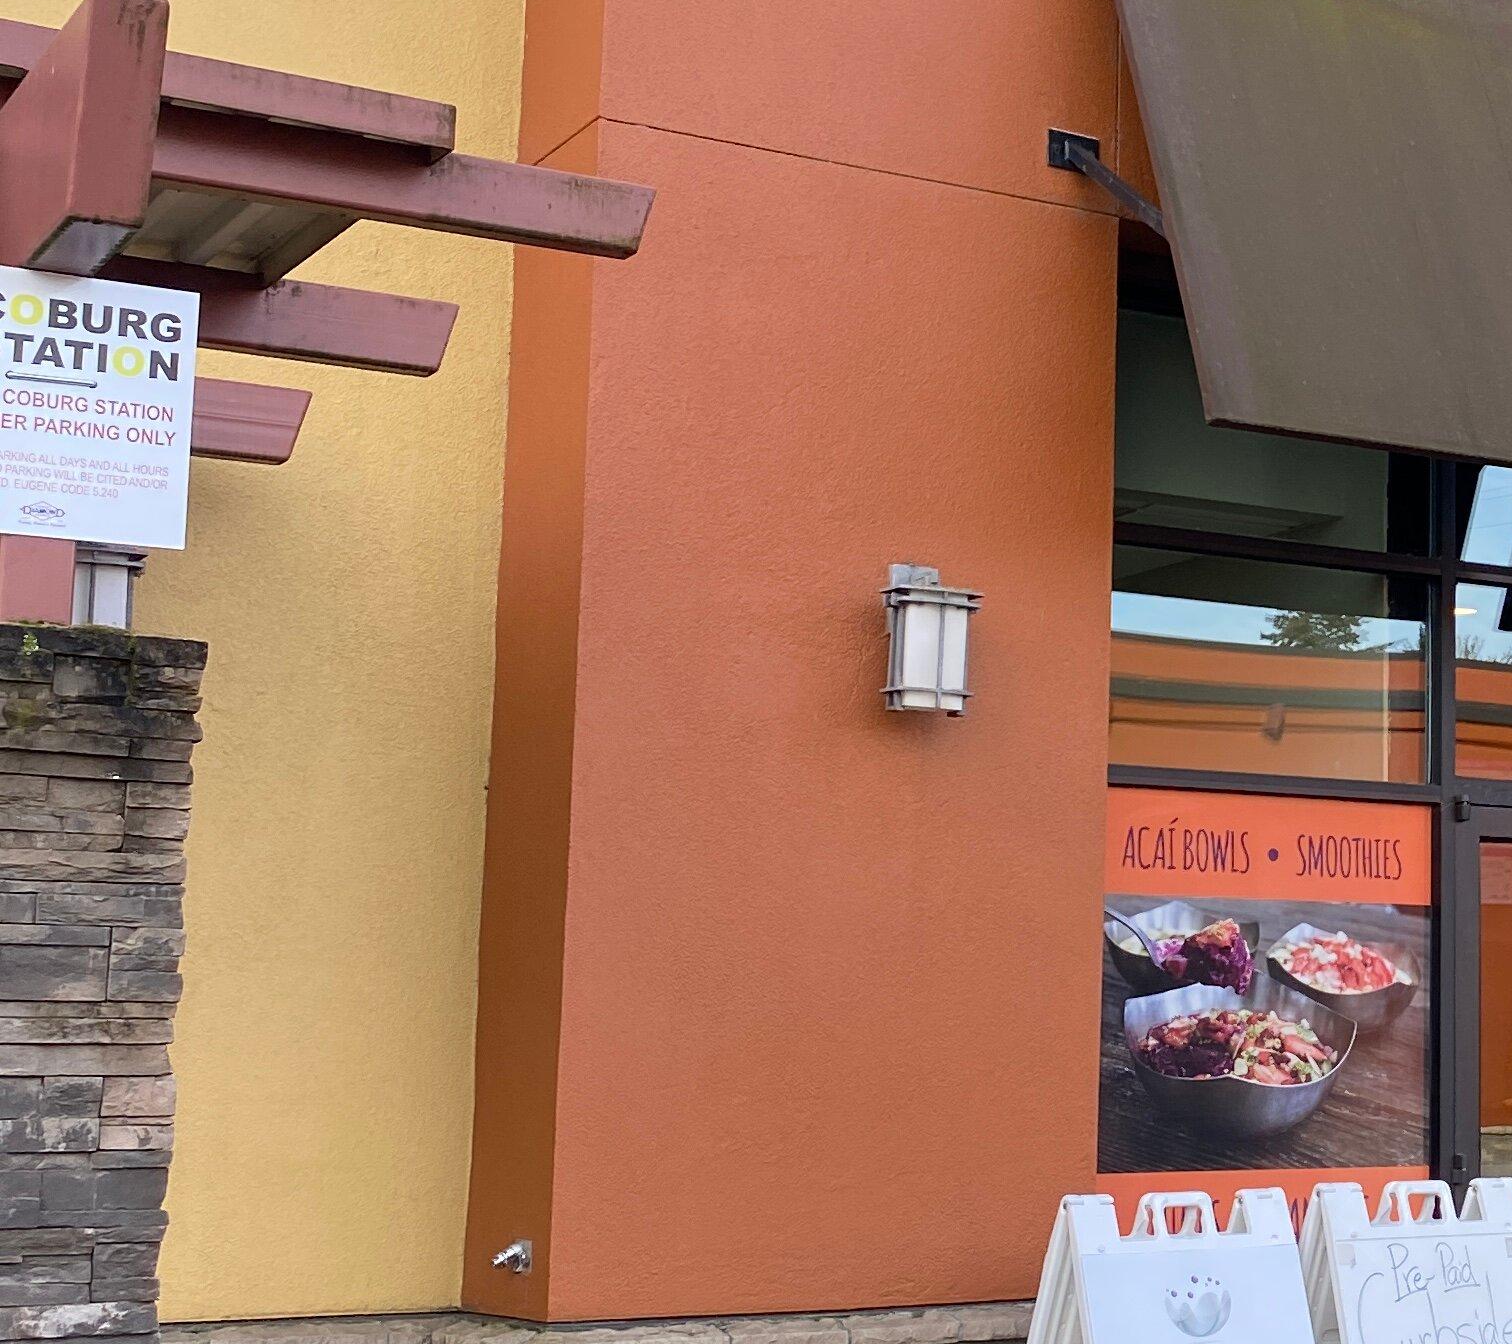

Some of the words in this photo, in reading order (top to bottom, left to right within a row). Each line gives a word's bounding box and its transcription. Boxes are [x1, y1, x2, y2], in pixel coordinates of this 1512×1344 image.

[0, 293, 182, 343] OBURG
[3, 388, 88, 413] COBURG
[95, 398, 174, 423] STATION
[34, 416, 120, 441] PARKING
[126, 427, 176, 447] ONLY
[5, 464, 51, 479] PARKING
[54, 469, 77, 481] WILL
[80, 471, 93, 482] BE
[97, 474, 127, 486] CITED
[39, 453, 57, 466] ALL
[60, 456, 87, 469] DAYS
[88, 459, 111, 471] AND
[113, 462, 130, 473] ALL
[133, 464, 169, 477] HOURS
[14, 478, 58, 493] EUGENE
[60, 483, 90, 496] CODE
[92, 486, 119, 499] 5.240
[1183, 828, 1250, 874] BOWLS
[1296, 834, 1402, 881] SMOOTHIES
[1387, 1241, 1479, 1301] Pre-Paid
